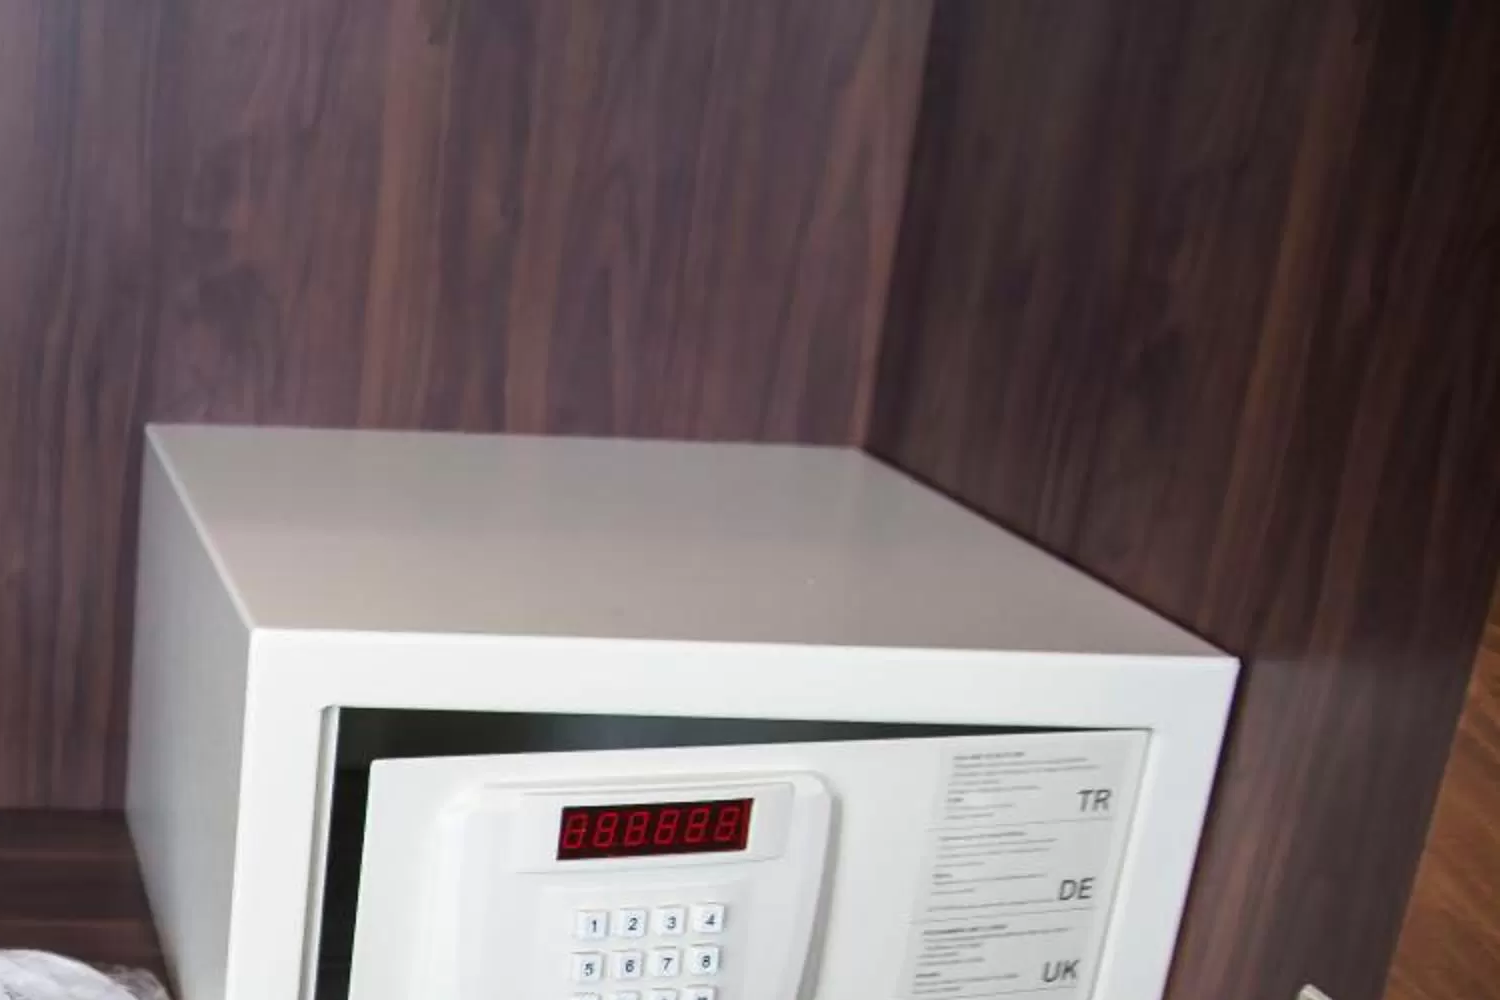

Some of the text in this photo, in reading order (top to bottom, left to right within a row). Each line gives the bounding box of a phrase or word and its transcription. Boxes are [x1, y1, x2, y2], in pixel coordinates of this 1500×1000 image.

[1077, 788, 1112, 812] TR
[1059, 876, 1096, 901] DE
[627, 917, 639, 931] 2
[667, 915, 677, 930] 3
[704, 914, 716, 926] 4
[583, 955, 712, 977] 5 6 7 8
[1041, 958, 1081, 983] UK
